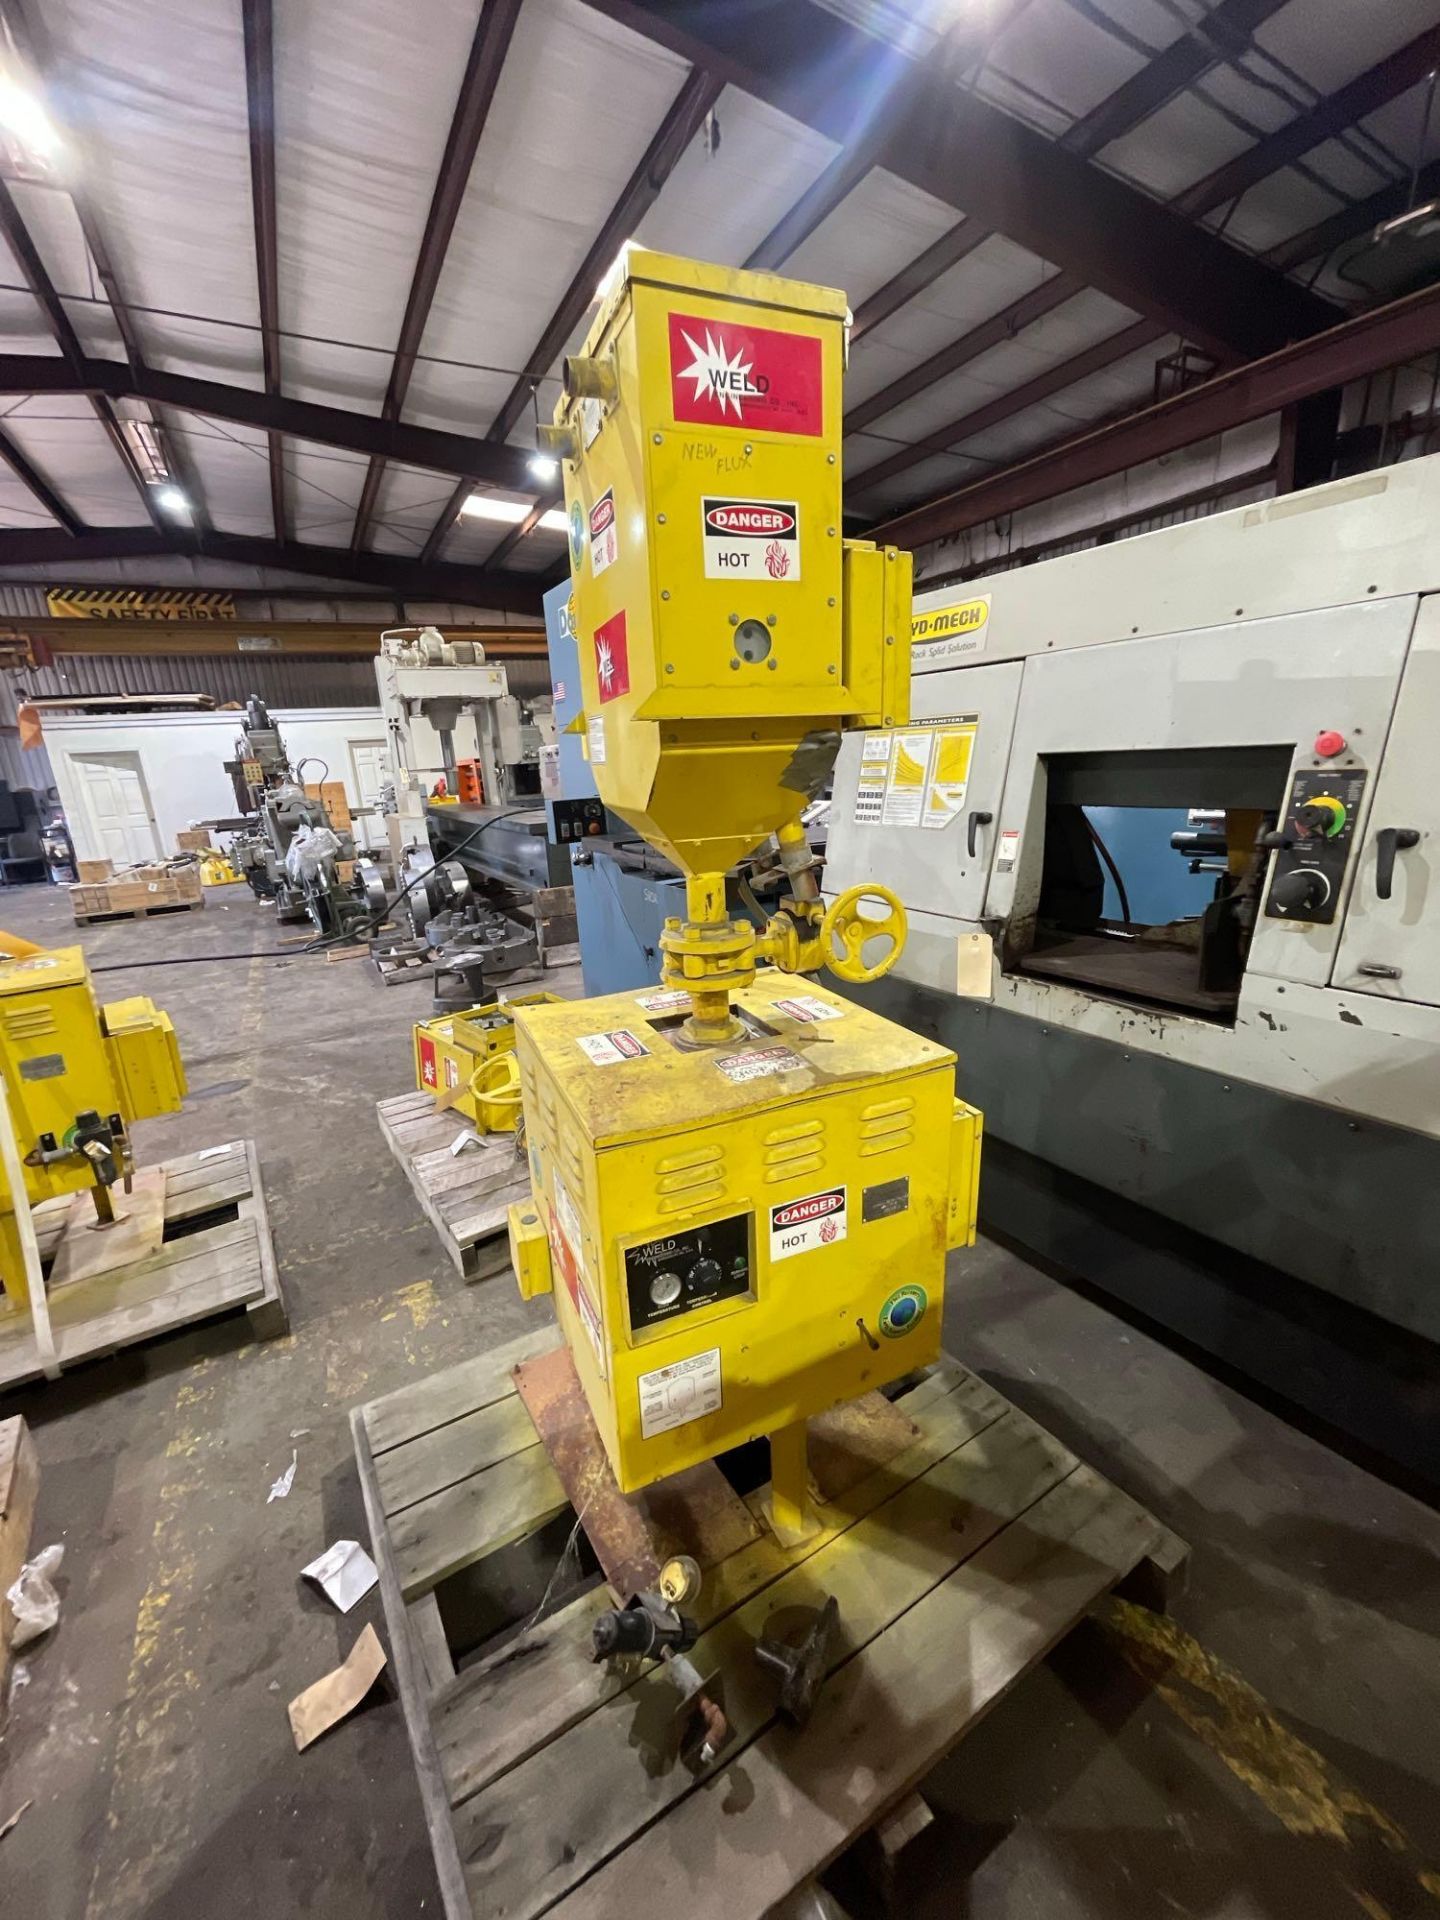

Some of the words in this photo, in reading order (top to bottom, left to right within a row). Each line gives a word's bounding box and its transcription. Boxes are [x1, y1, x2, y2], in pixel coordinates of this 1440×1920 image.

[708, 368, 770, 394] WELD
[682, 442, 718, 461] NEW
[716, 455, 752, 474] FLUX
[715, 511, 784, 529] DANGER
[718, 552, 750, 567] HOT
[720, 1048, 786, 1067] DANGER
[780, 1197, 837, 1223] DANGER
[642, 1239, 677, 1257] WELD
[781, 1232, 808, 1249] HOT
